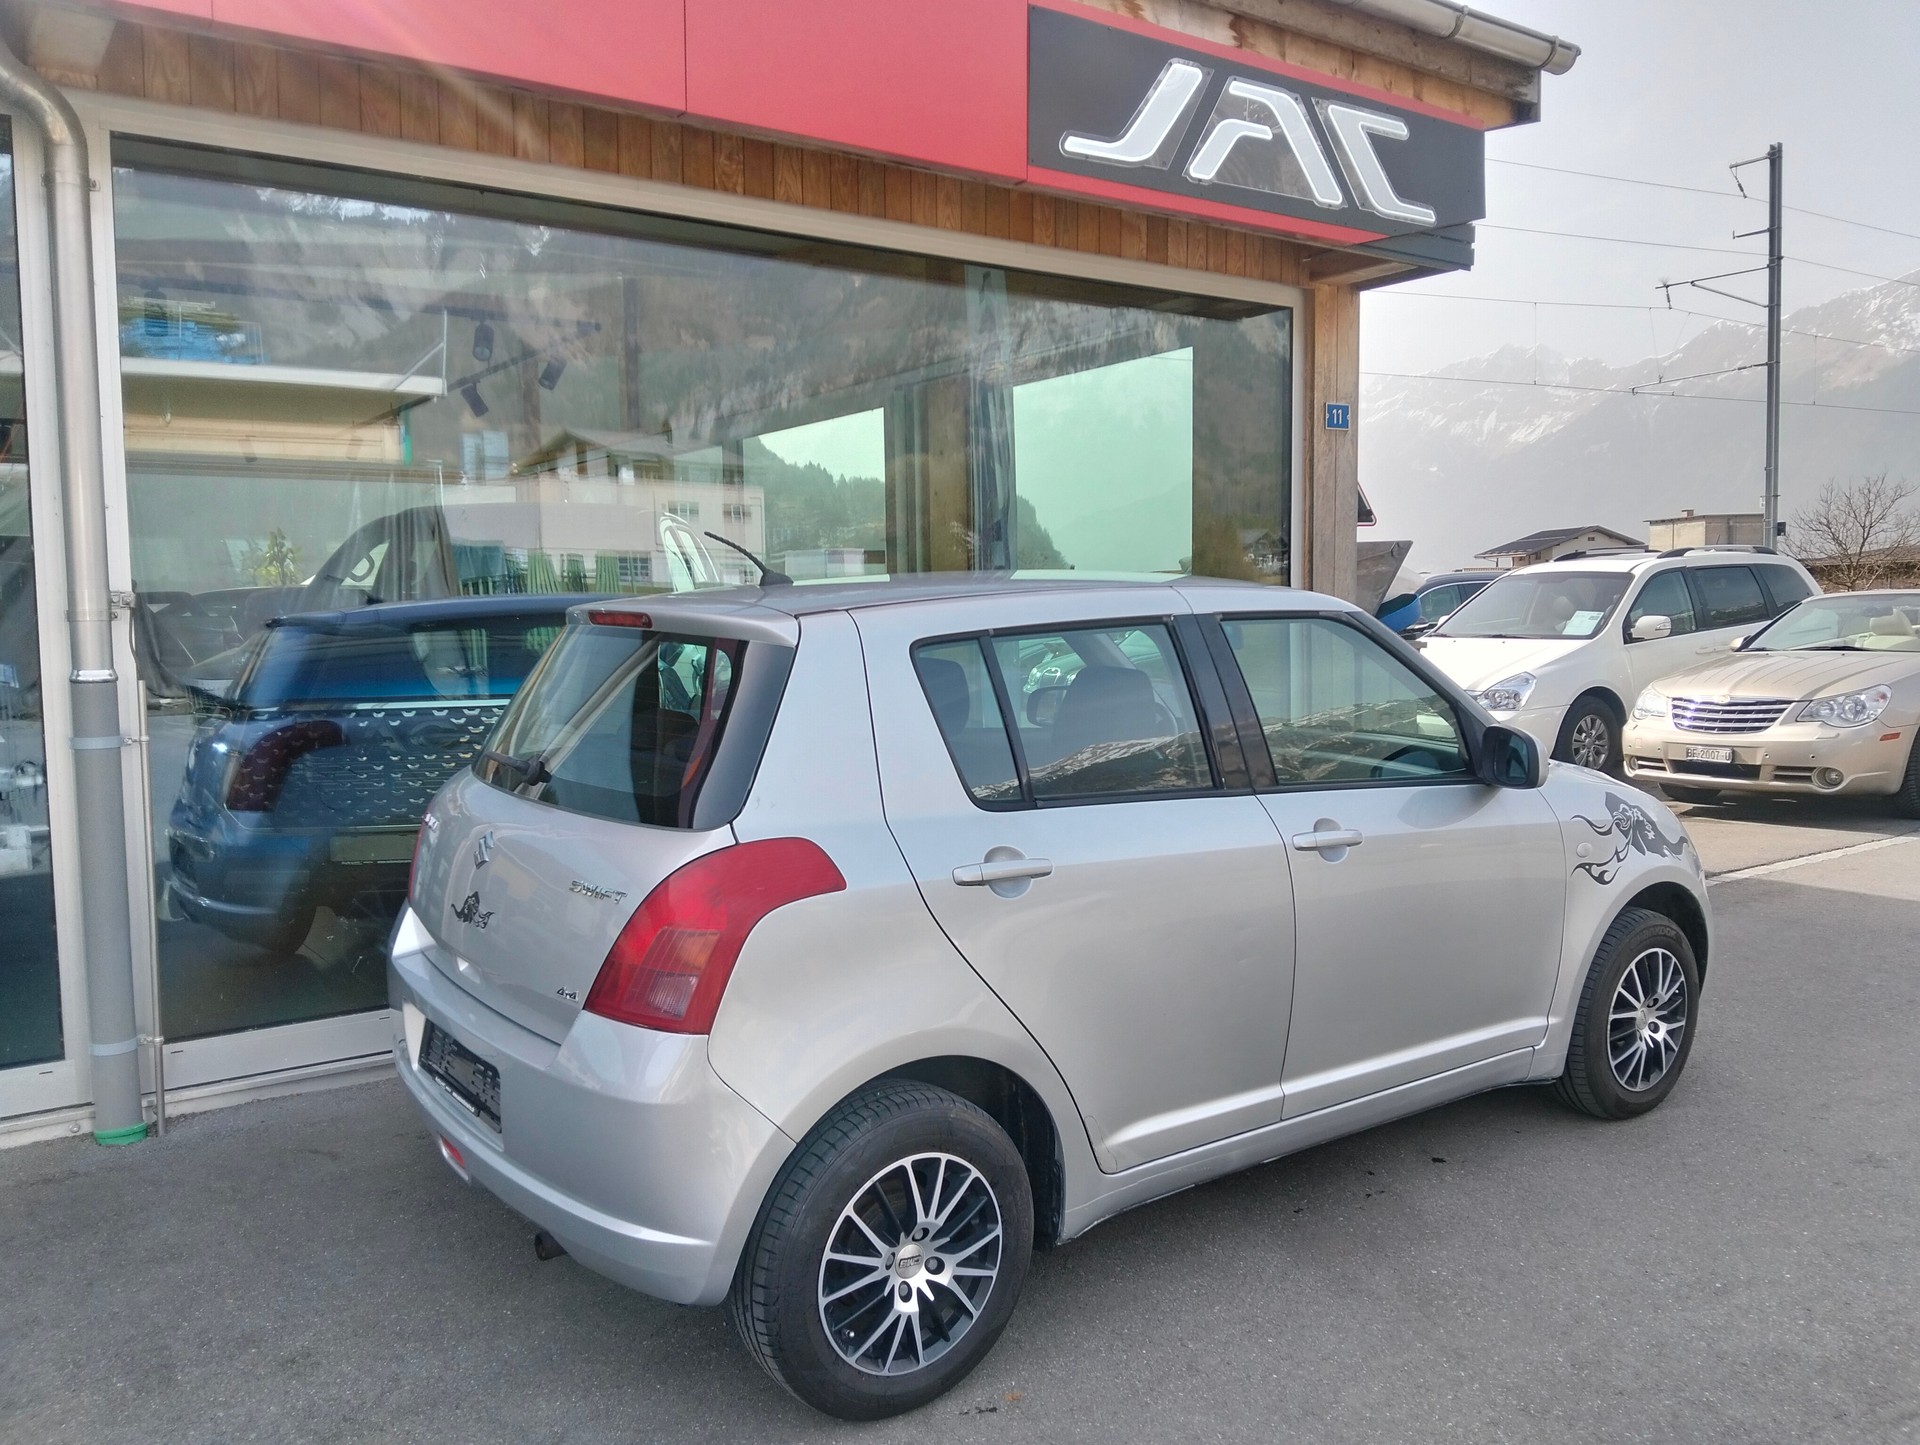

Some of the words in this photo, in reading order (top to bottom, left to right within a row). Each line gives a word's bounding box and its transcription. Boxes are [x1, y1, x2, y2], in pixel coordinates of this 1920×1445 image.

[1060, 59, 1437, 225] JAC
[1332, 408, 1343, 425] 11
[569, 880, 627, 904] SWIFT
